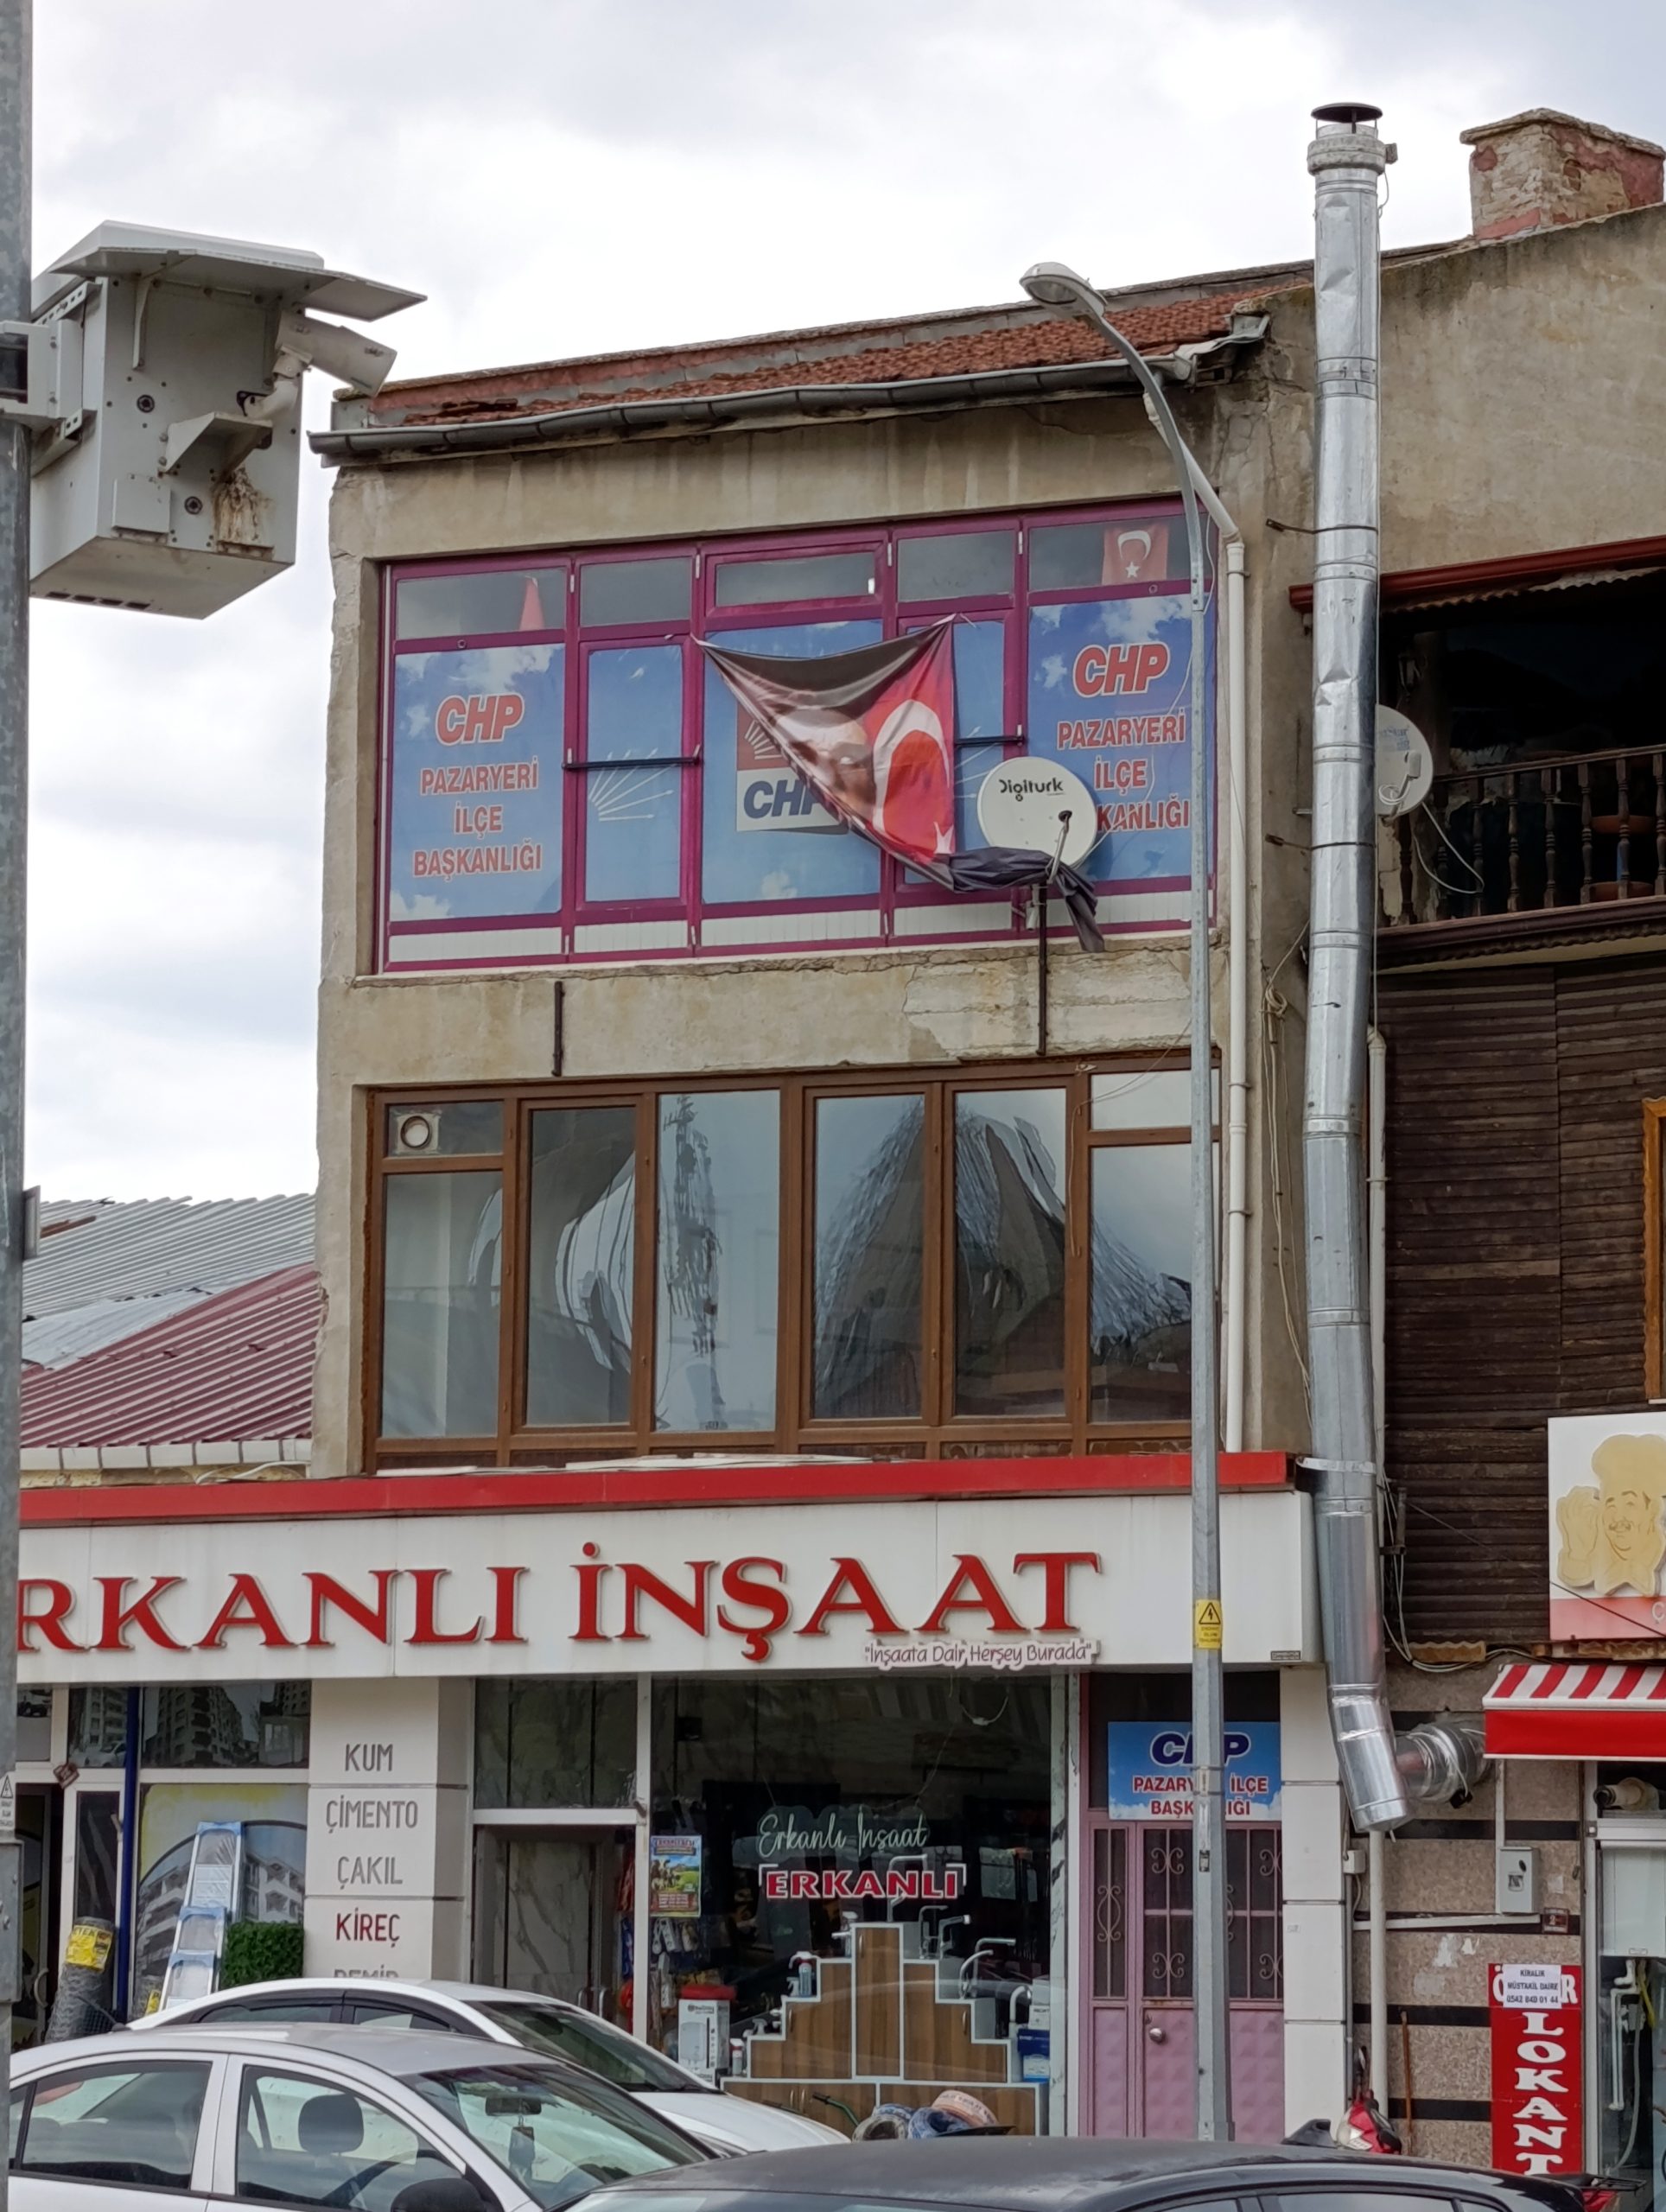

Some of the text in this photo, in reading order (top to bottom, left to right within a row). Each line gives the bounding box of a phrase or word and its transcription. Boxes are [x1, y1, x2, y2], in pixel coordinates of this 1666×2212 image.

[1074, 642, 1170, 697] CHP
[436, 694, 525, 746] CHP
[1057, 708, 1187, 749] PAZARYERİ
[420, 757, 538, 795] PAZARYERİ
[1094, 754, 1148, 795] İLÇE
[454, 804, 503, 839] İLÇE
[1096, 794, 1191, 833] KANLIĞI
[413, 838, 542, 881] BAŞKANLIĞI
[569, 1541, 1101, 1661] İNŞAAT
[346, 1744, 393, 1771] KUM
[1151, 1732, 1251, 1767] CP
[1230, 1773, 1269, 1796] İLÇE
[326, 1795, 418, 1834] ÇİMENTO
[337, 1857, 403, 1890] ÇAKIL
[766, 1870, 958, 1899] ERKANLI
[335, 1907, 401, 1948] KİREÇ
